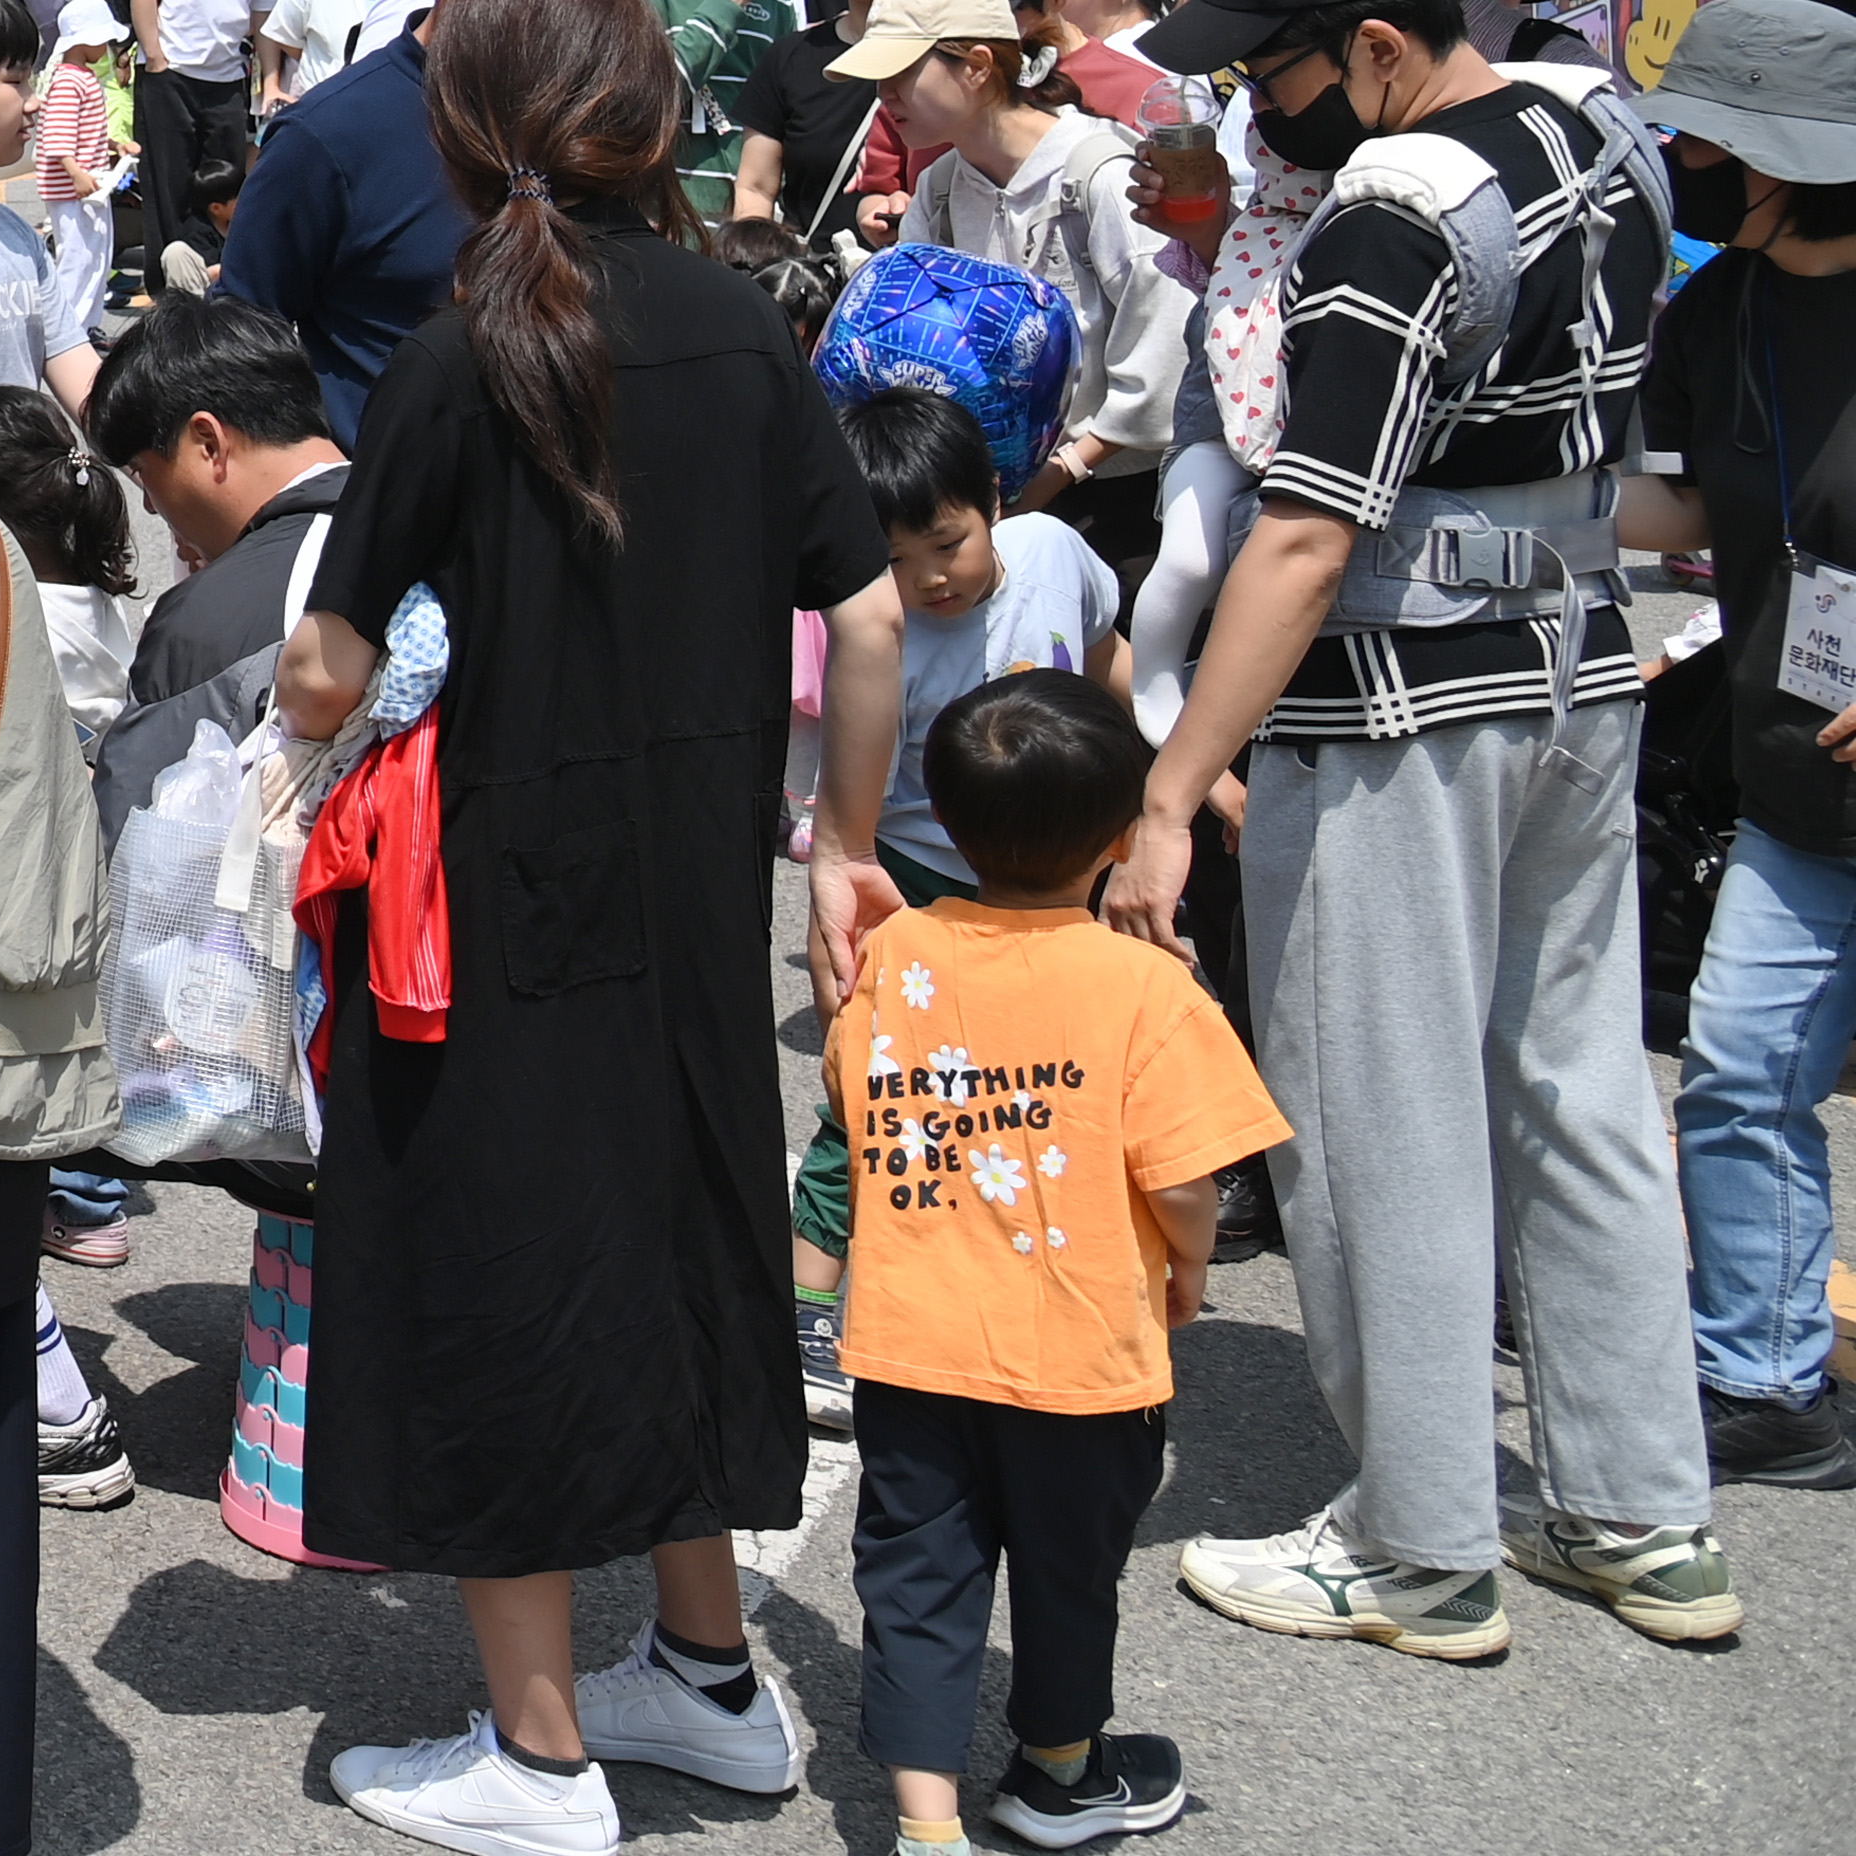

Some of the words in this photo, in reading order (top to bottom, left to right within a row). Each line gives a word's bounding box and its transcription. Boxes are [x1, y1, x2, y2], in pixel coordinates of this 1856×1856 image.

[893, 361, 944, 385] SUPER
[1807, 629, 1841, 657] 사천
[1788, 645, 1856, 688] 문화재단
[867, 1060, 1084, 1101] VERYTHING
[866, 1108, 902, 1137] IS
[922, 1100, 1053, 1140] GOING
[862, 1147, 908, 1176] TO
[926, 1144, 962, 1173] BE
